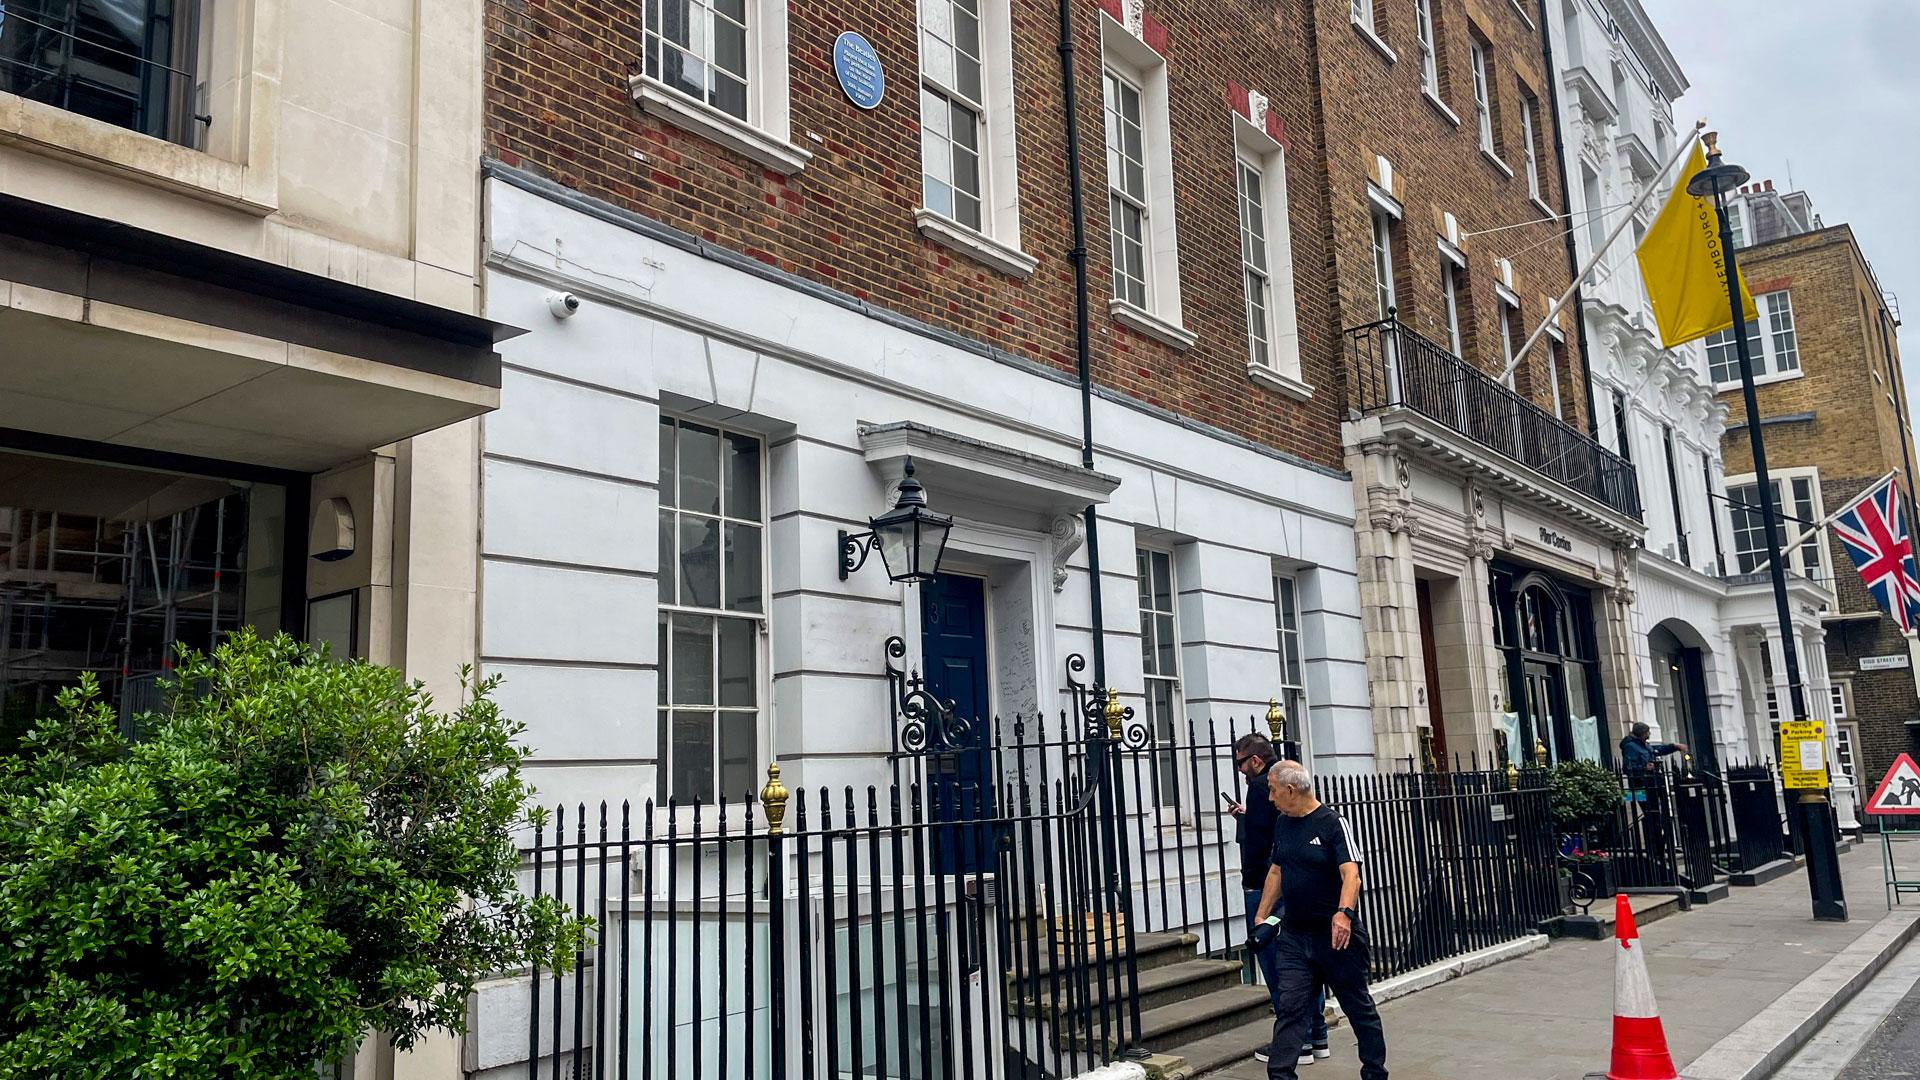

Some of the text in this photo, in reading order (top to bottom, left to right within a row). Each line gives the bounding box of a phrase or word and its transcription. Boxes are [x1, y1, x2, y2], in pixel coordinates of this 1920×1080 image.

[843, 37, 876, 63] The Beatles
[1699, 211, 1731, 306] UXEMBOURG
[930, 602, 939, 624] 3
[1417, 687, 1425, 705] 2
[1493, 694, 1500, 710] 2
